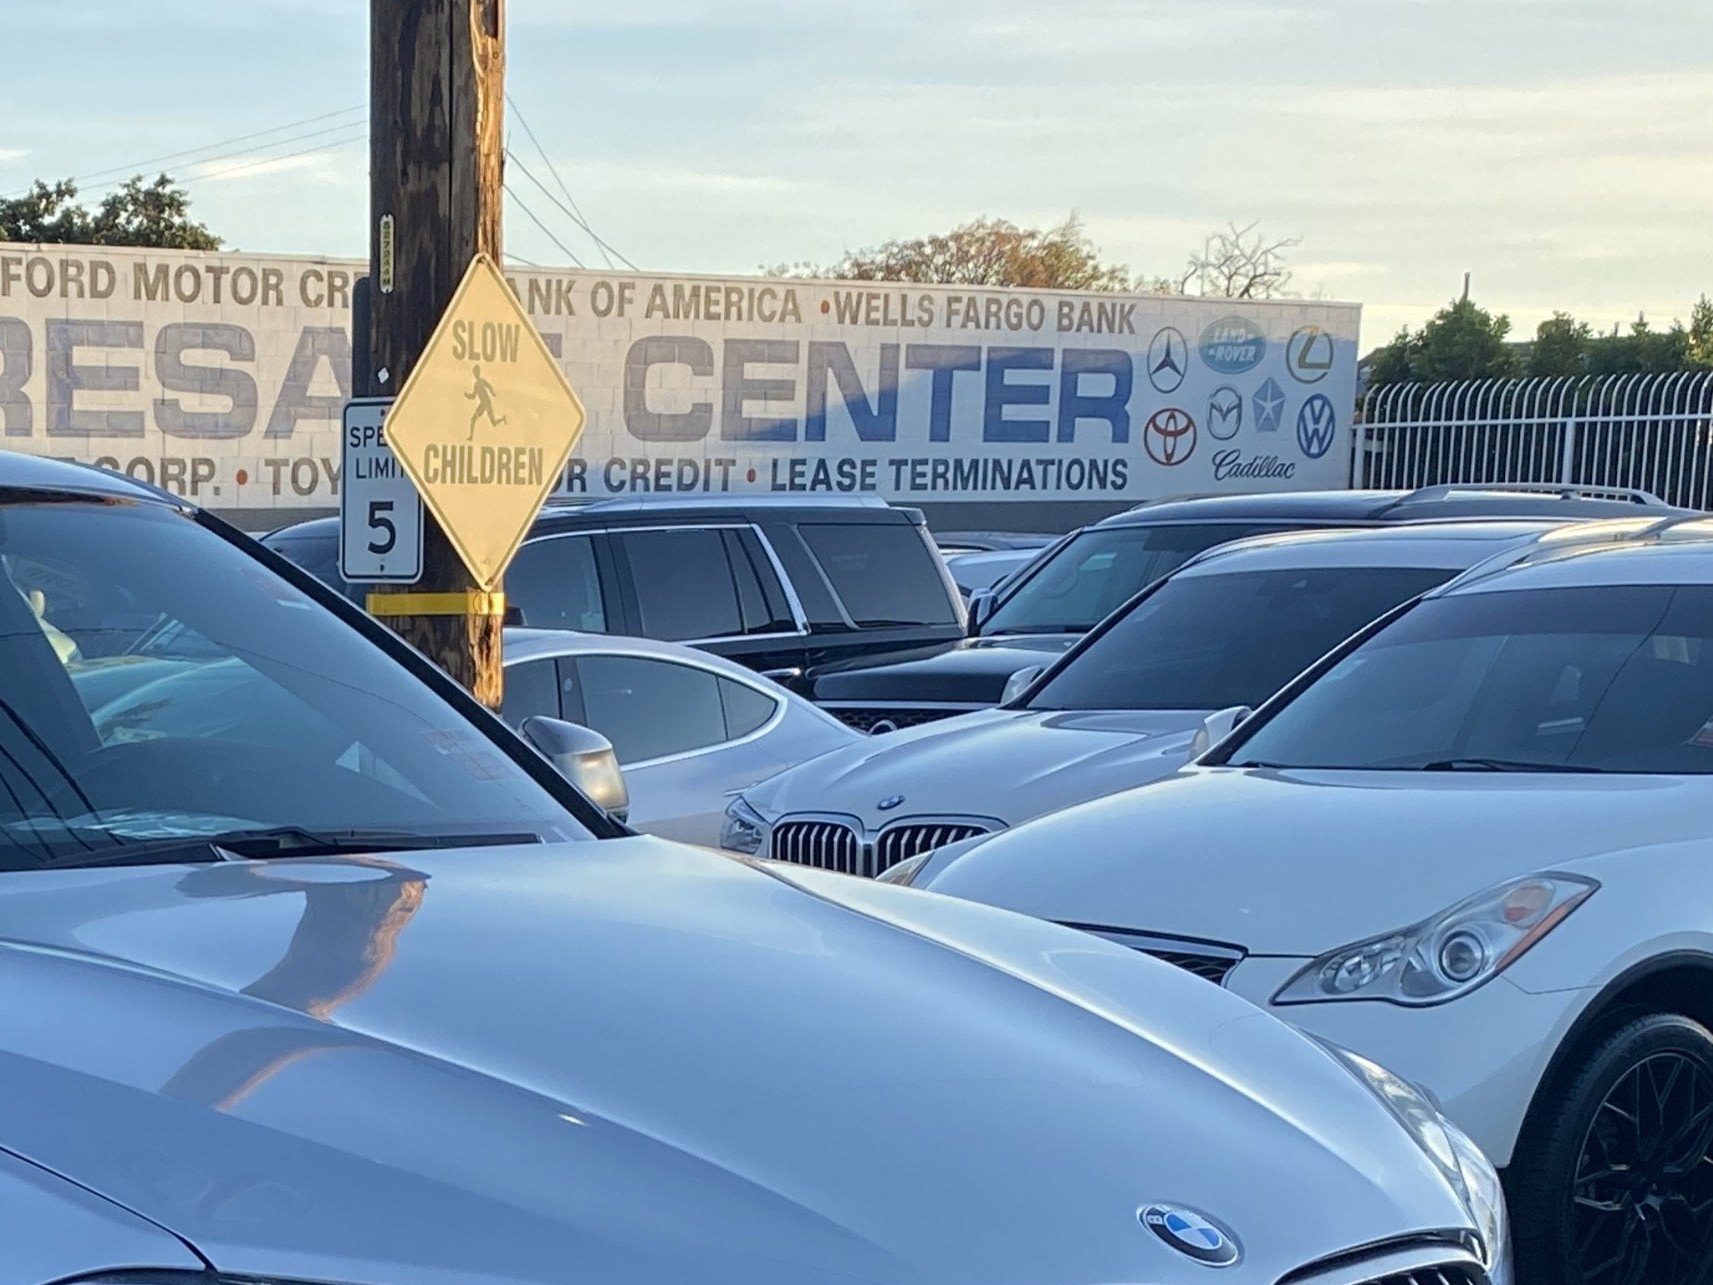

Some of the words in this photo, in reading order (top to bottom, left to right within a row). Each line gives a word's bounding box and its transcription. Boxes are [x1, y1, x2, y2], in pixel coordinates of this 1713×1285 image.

[0, 256, 116, 298] FORD
[133, 263, 285, 307] MOTOR
[590, 280, 635, 317] OF
[644, 283, 802, 323] AMERICA
[832, 292, 934, 328] WELLS
[944, 296, 1047, 332] FARGO
[1057, 300, 1137, 334] BANK
[453, 320, 521, 363] SLOW
[1214, 327, 1248, 344] LAND
[1215, 345, 1256, 363] ROVER
[624, 335, 1132, 443] CENTER
[350, 425, 388, 448] SPE
[424, 444, 544, 486] CHILDREN
[603, 457, 736, 493] CREDIT
[770, 458, 877, 491] LEASE
[888, 458, 1128, 491] TERMINATIONS
[1212, 449, 1295, 481] Cadillac
[368, 502, 396, 555] 5
